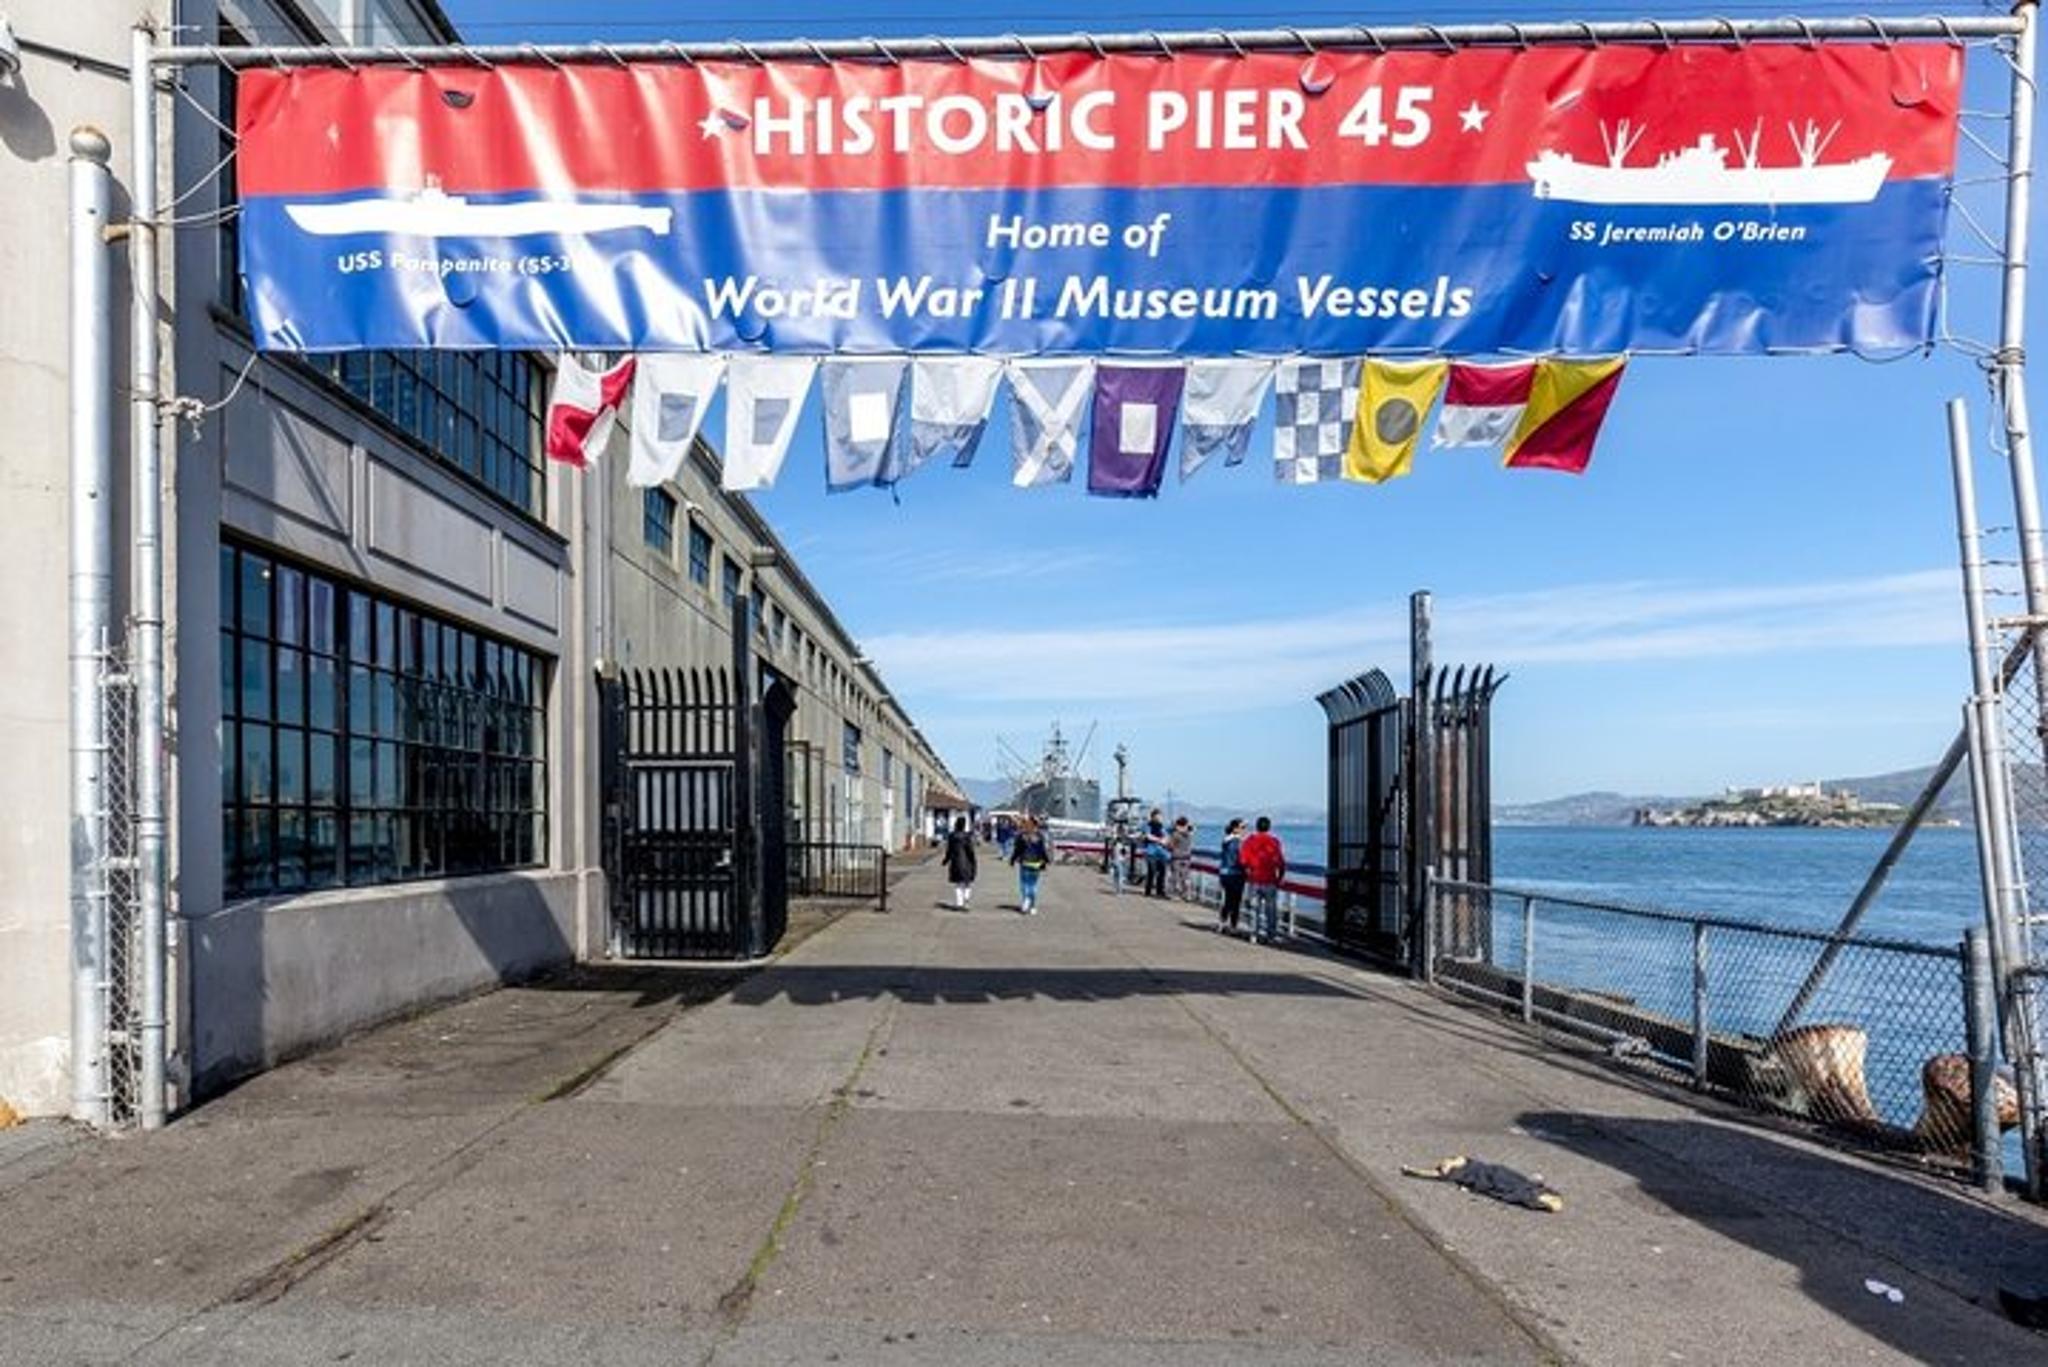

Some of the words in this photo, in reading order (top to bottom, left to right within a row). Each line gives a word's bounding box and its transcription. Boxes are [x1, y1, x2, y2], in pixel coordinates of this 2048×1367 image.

[754, 89, 1115, 155] HISTORIC
[1147, 89, 1308, 150] PIER
[1338, 86, 1434, 147] 45
[986, 213, 1111, 250] Home
[1123, 214, 1171, 257] of
[1570, 221, 1596, 240] SS
[1599, 222, 1704, 246] Jeremiah
[1713, 221, 1806, 241] O'Brien
[338, 251, 382, 273] USS
[704, 276, 861, 321] World
[876, 276, 983, 320] War
[1001, 278, 1035, 319] II
[1054, 275, 1278, 320] Museum
[1297, 275, 1474, 320] Vessels
